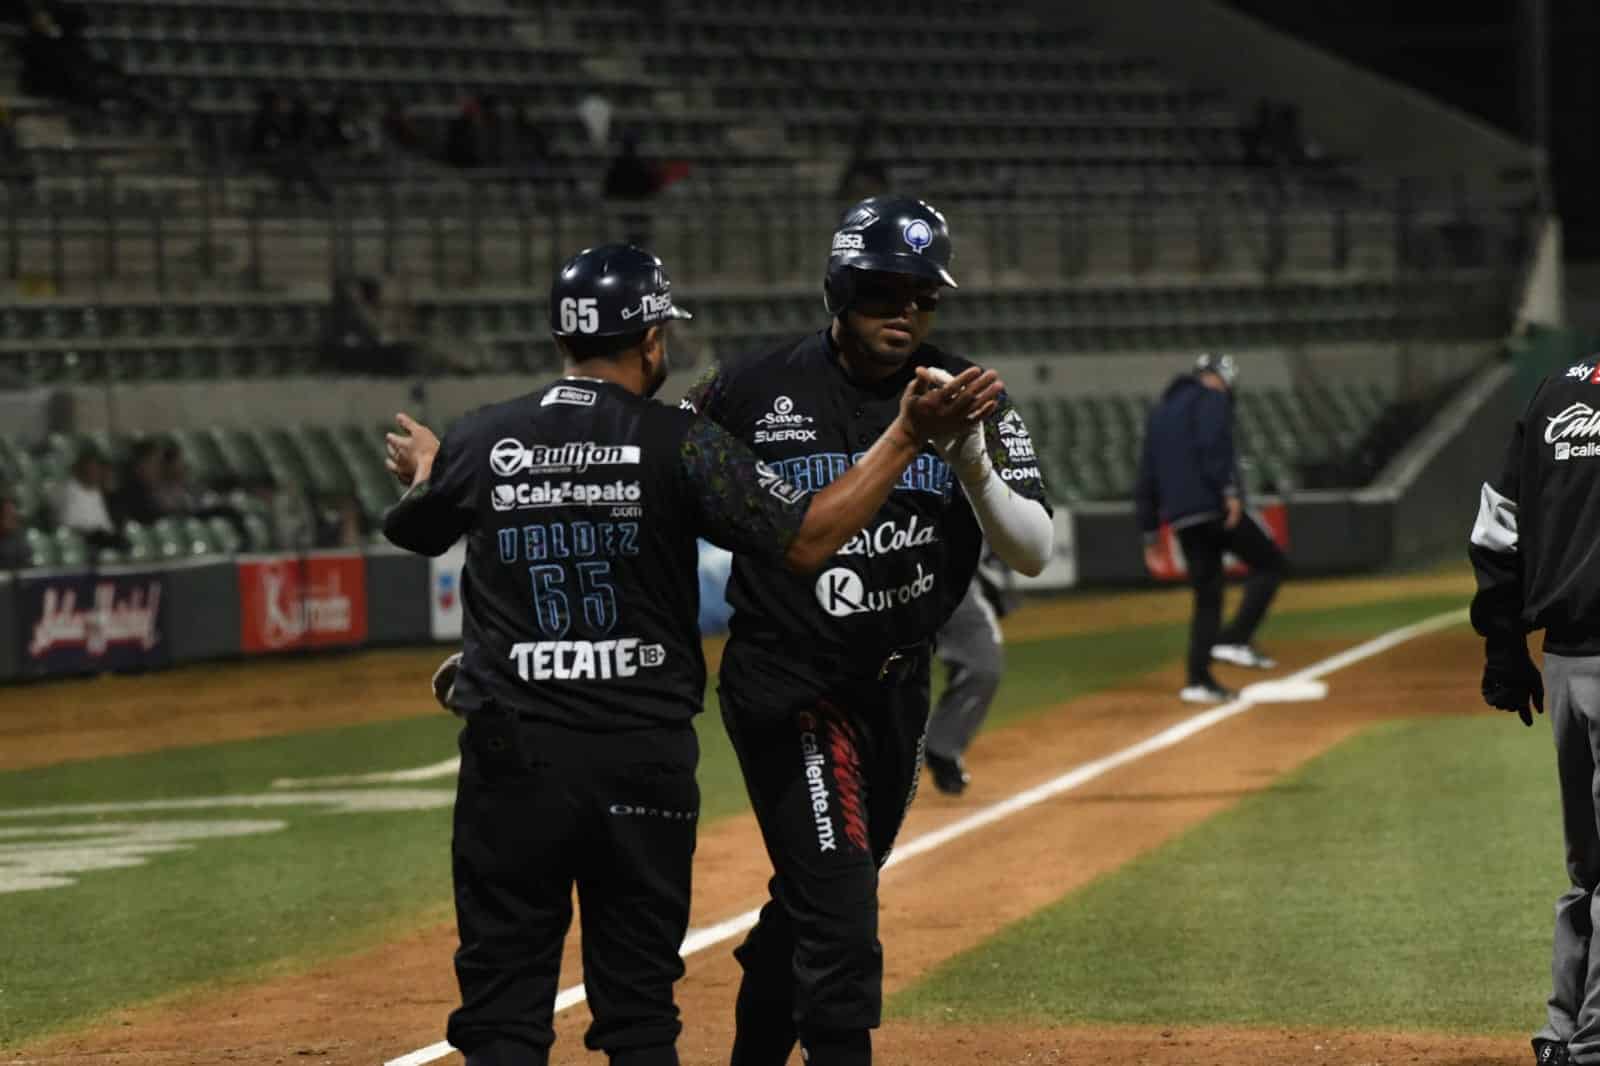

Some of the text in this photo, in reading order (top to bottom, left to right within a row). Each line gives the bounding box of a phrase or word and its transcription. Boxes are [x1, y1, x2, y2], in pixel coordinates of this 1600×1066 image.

[560, 298, 599, 334] 65
[1565, 363, 1595, 381] sky
[754, 429, 816, 443] SUEROX
[764, 412, 803, 424] Save
[531, 442, 624, 472] Bullfon
[497, 522, 640, 563] VALDEZ
[873, 515, 939, 554] Cola
[529, 561, 618, 641] 65
[826, 563, 935, 612] Kuroda
[509, 638, 641, 682] TECATE
[801, 731, 837, 852] caliente.mx
